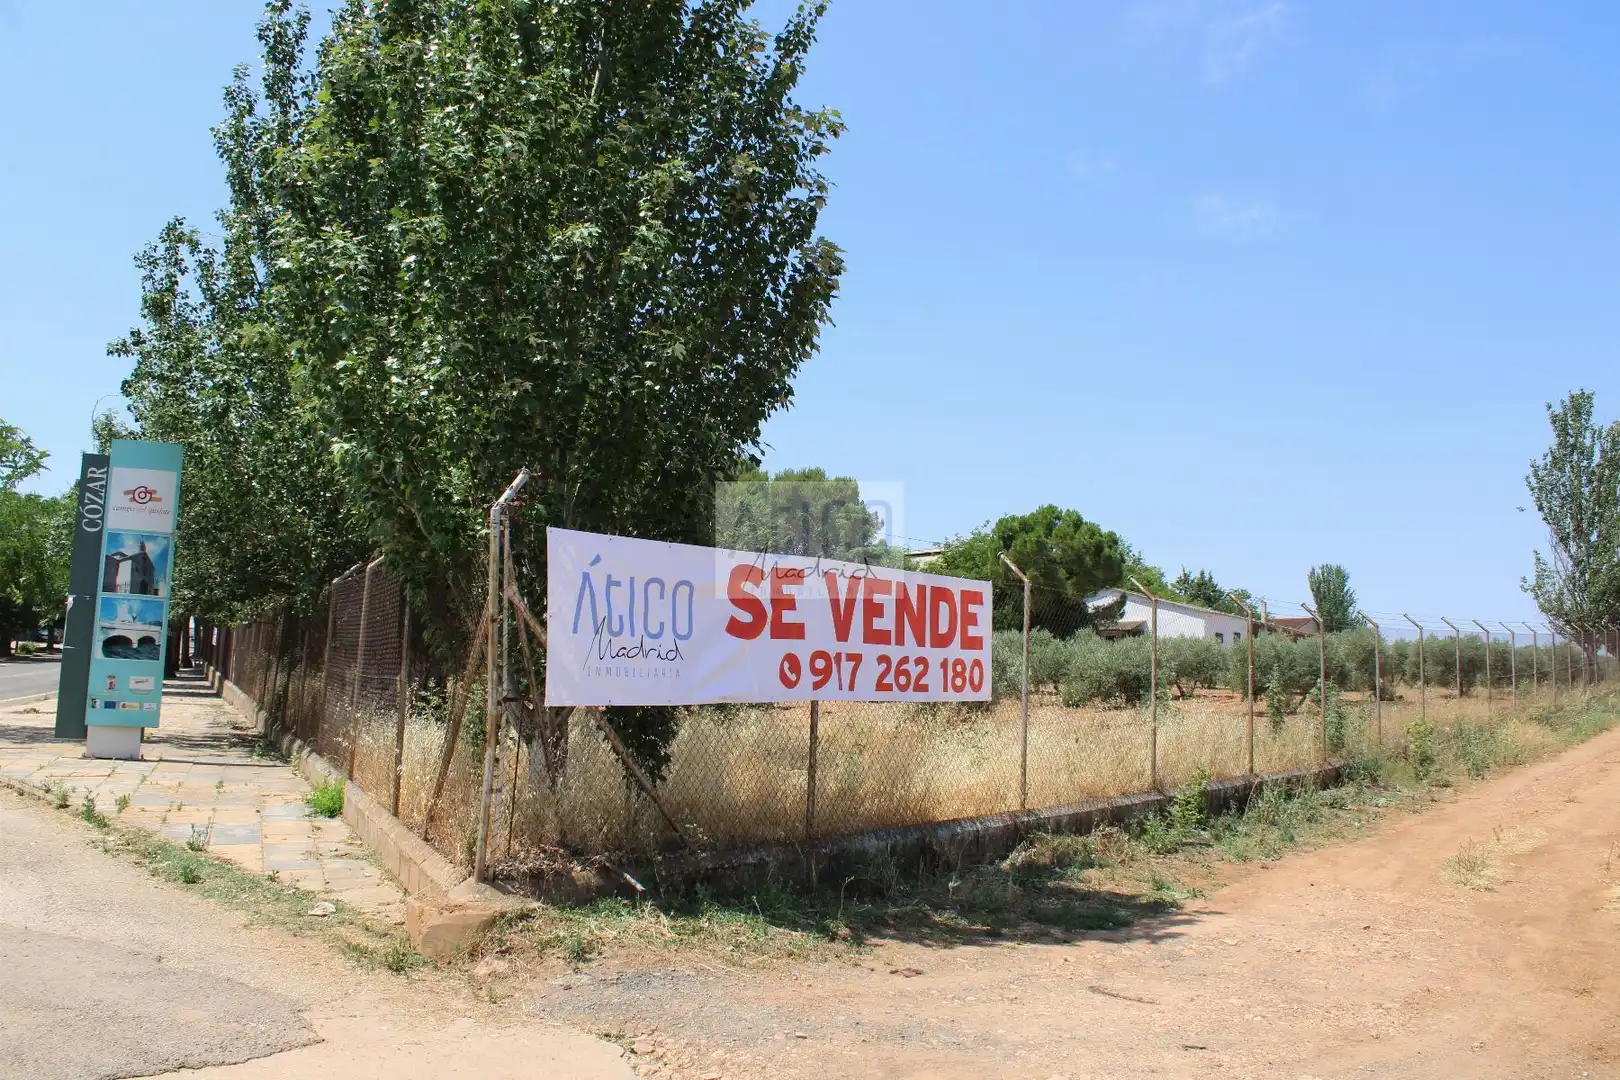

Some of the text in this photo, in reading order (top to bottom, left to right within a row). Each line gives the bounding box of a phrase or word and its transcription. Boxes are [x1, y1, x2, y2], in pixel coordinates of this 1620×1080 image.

[81, 466, 107, 532] CÓZAR
[725, 563, 984, 651] SE VENDE
[583, 615, 684, 671] Madrid
[587, 665, 681, 678] INMOBILIARIA
[809, 650, 985, 693] 917 262 180
